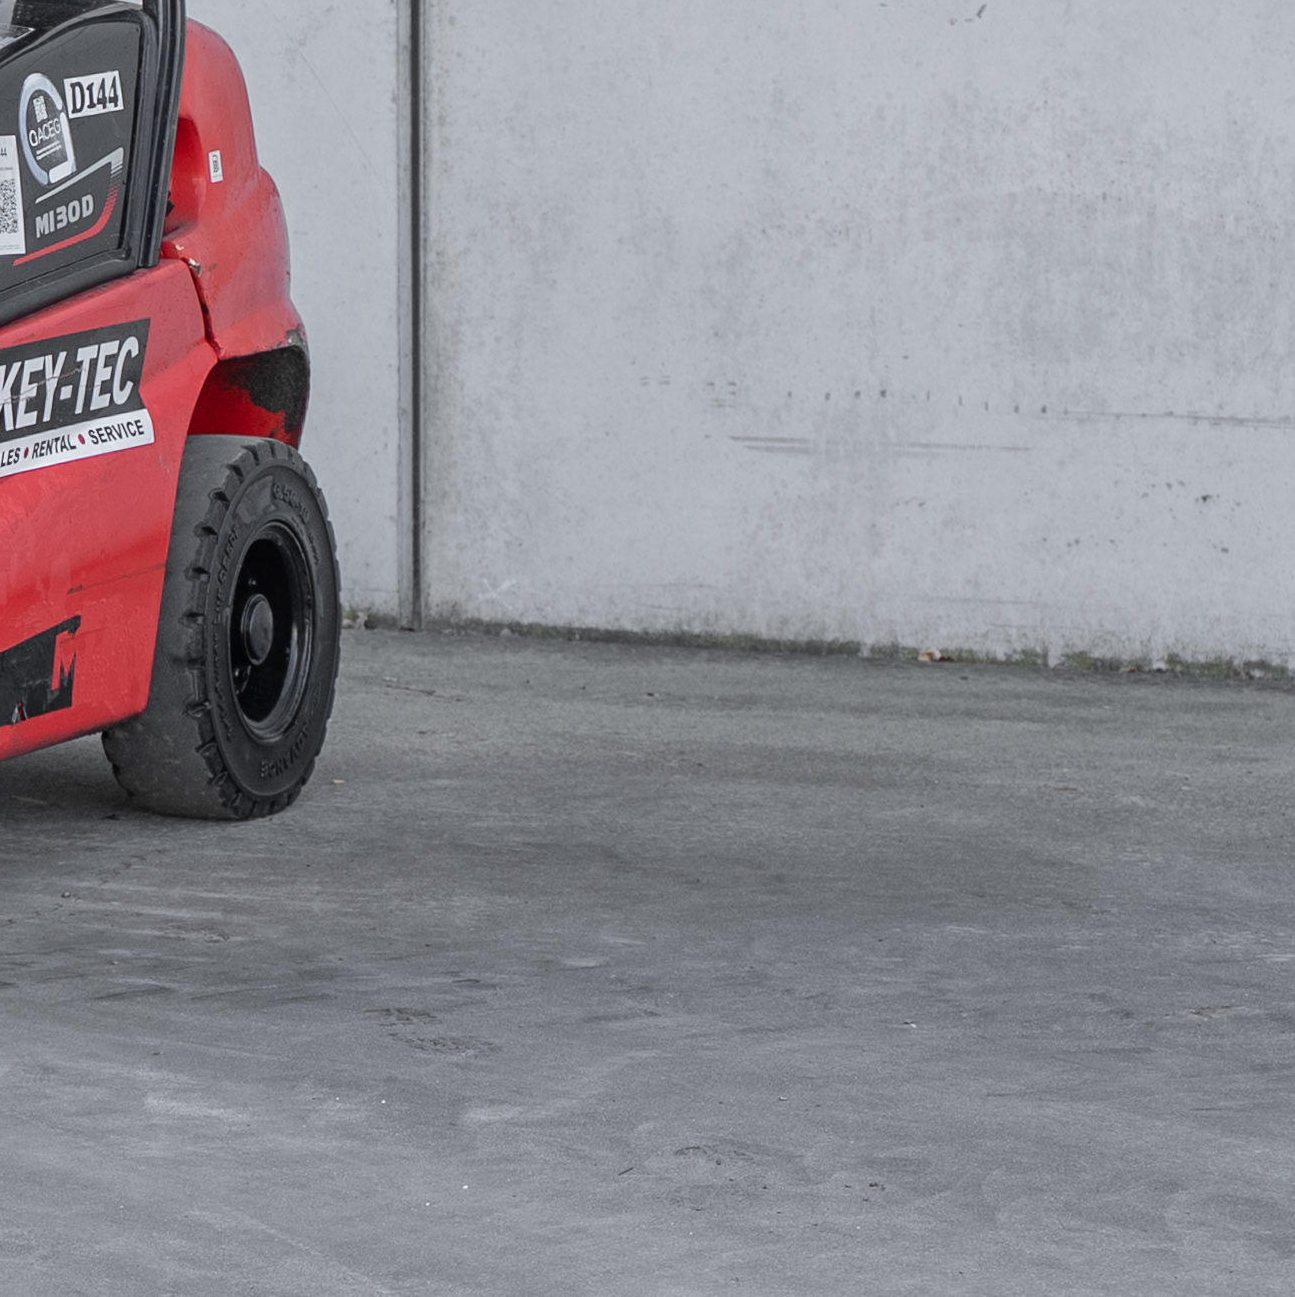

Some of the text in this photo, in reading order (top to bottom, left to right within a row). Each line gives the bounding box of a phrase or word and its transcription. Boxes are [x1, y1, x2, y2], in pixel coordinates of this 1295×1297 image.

[70, 75, 119, 114] D144
[31, 434, 77, 459] RENTAL
[88, 419, 145, 445] SERVICE
